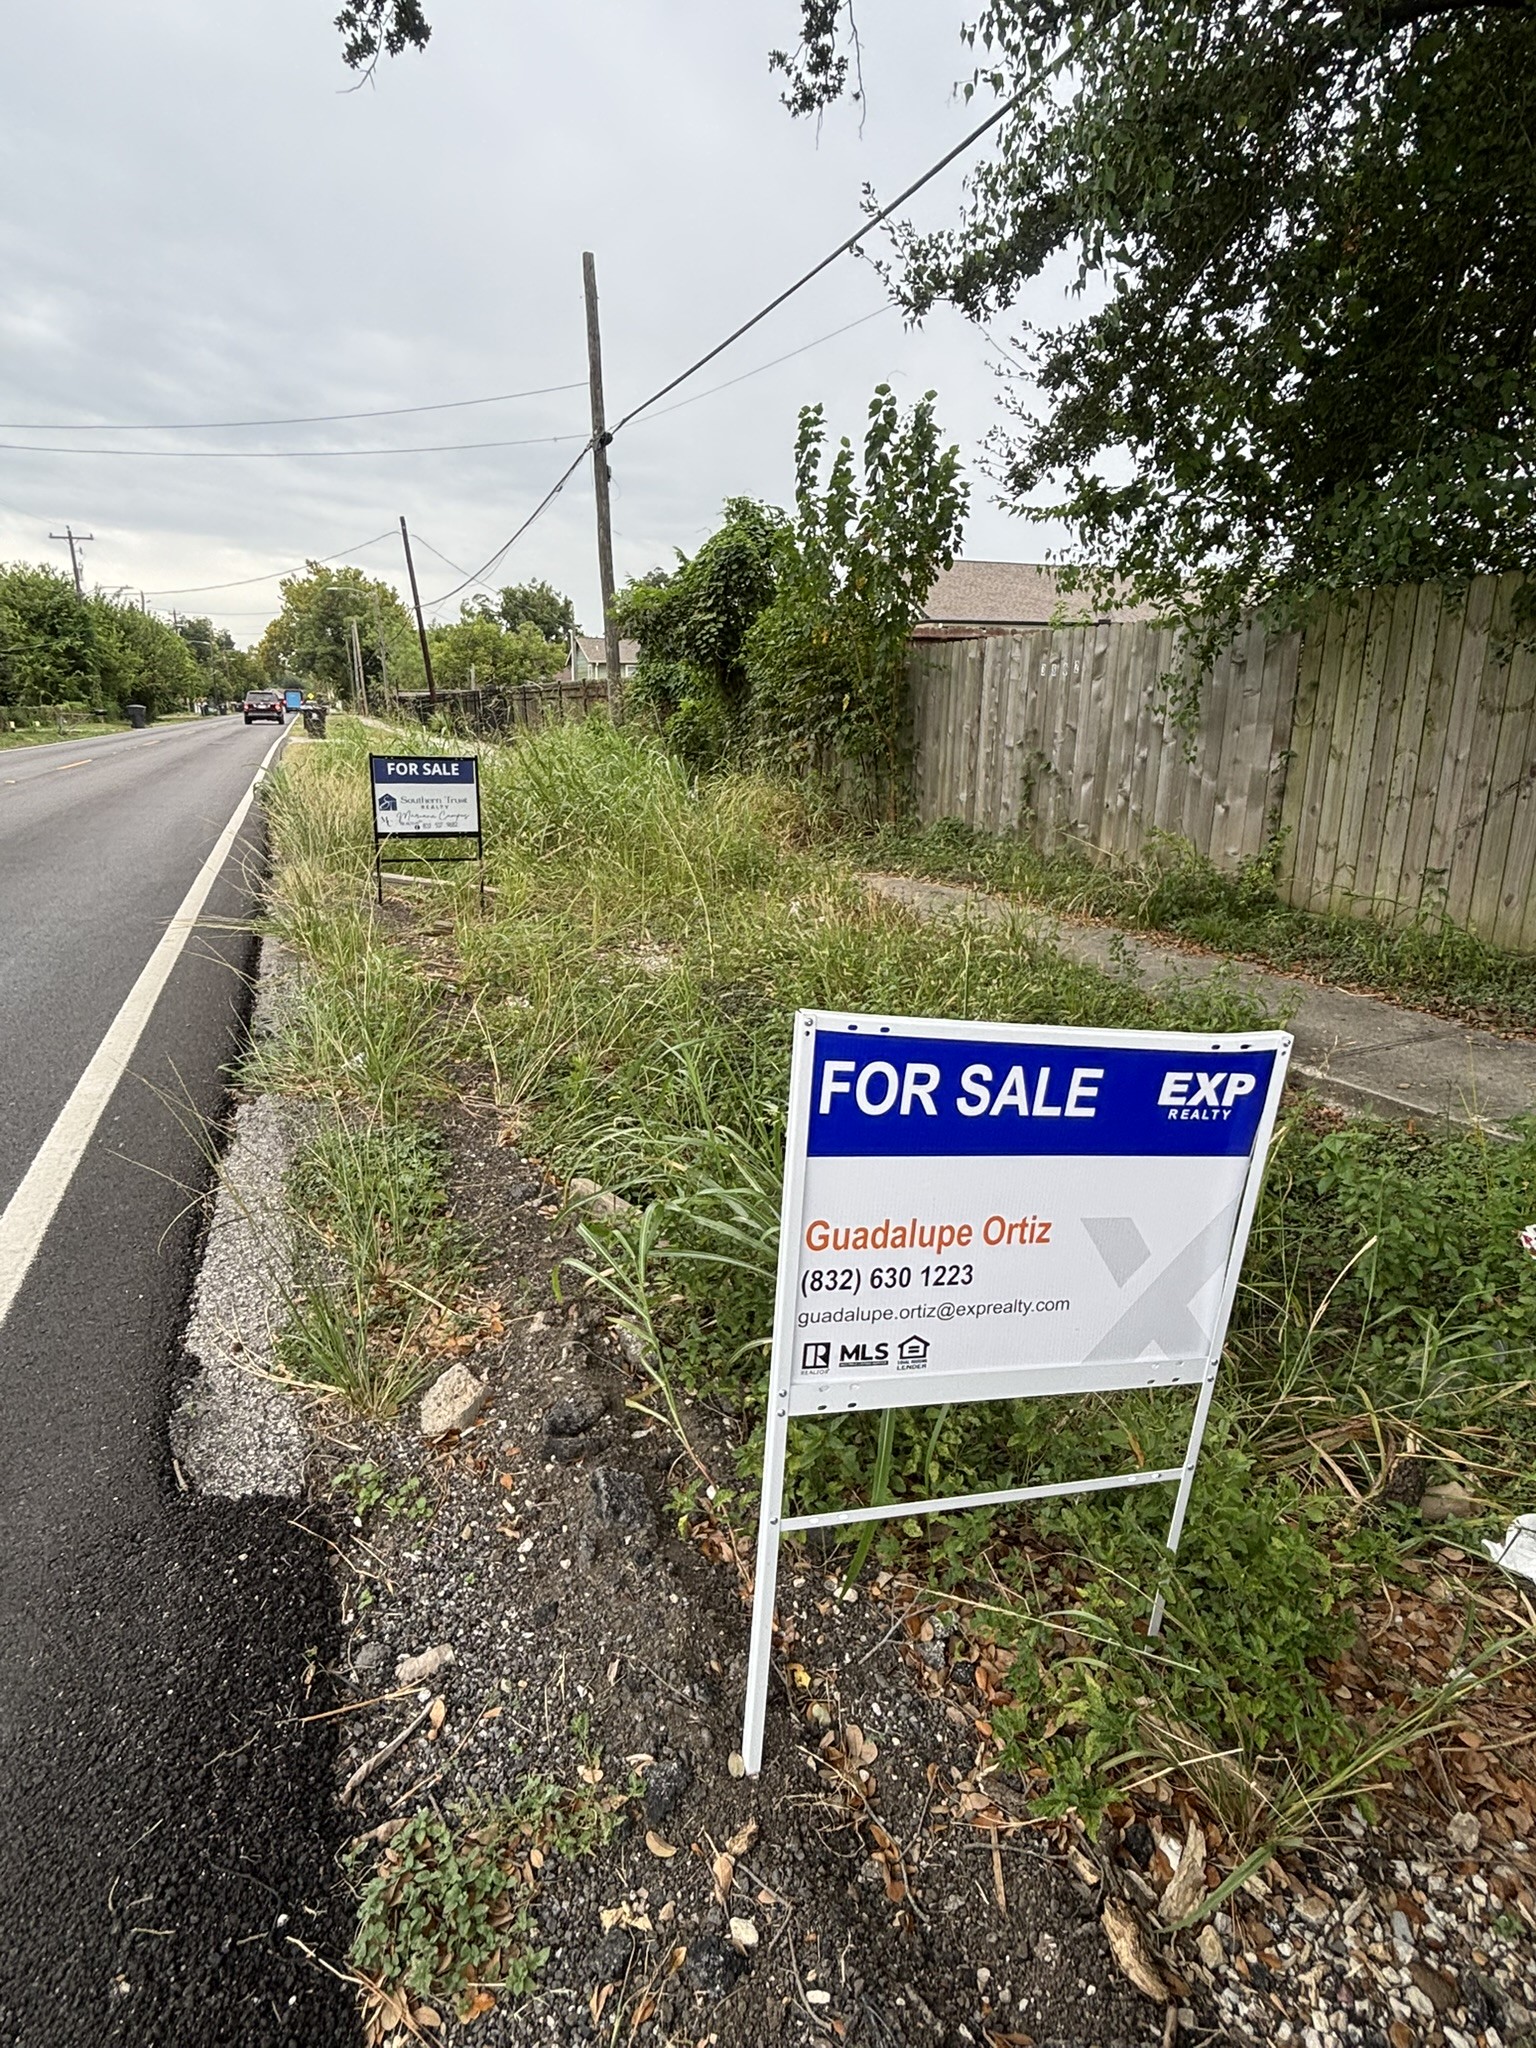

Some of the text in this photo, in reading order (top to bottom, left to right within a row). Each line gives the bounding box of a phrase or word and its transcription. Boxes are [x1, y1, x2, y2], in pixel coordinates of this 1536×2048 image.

[387, 763, 459, 776] FOR SALE
[819, 1060, 1105, 1118] FOR SALE
[1157, 1071, 1256, 1107] EXP
[1167, 1108, 1232, 1121] REALTY
[805, 1215, 1052, 1254] Guadalupe Ortiz
[801, 1263, 974, 1299] (832) 630 1223
[797, 1298, 1070, 1329] guadalupe.ortiz@exprealty.com
[838, 1342, 889, 1362] MLS
